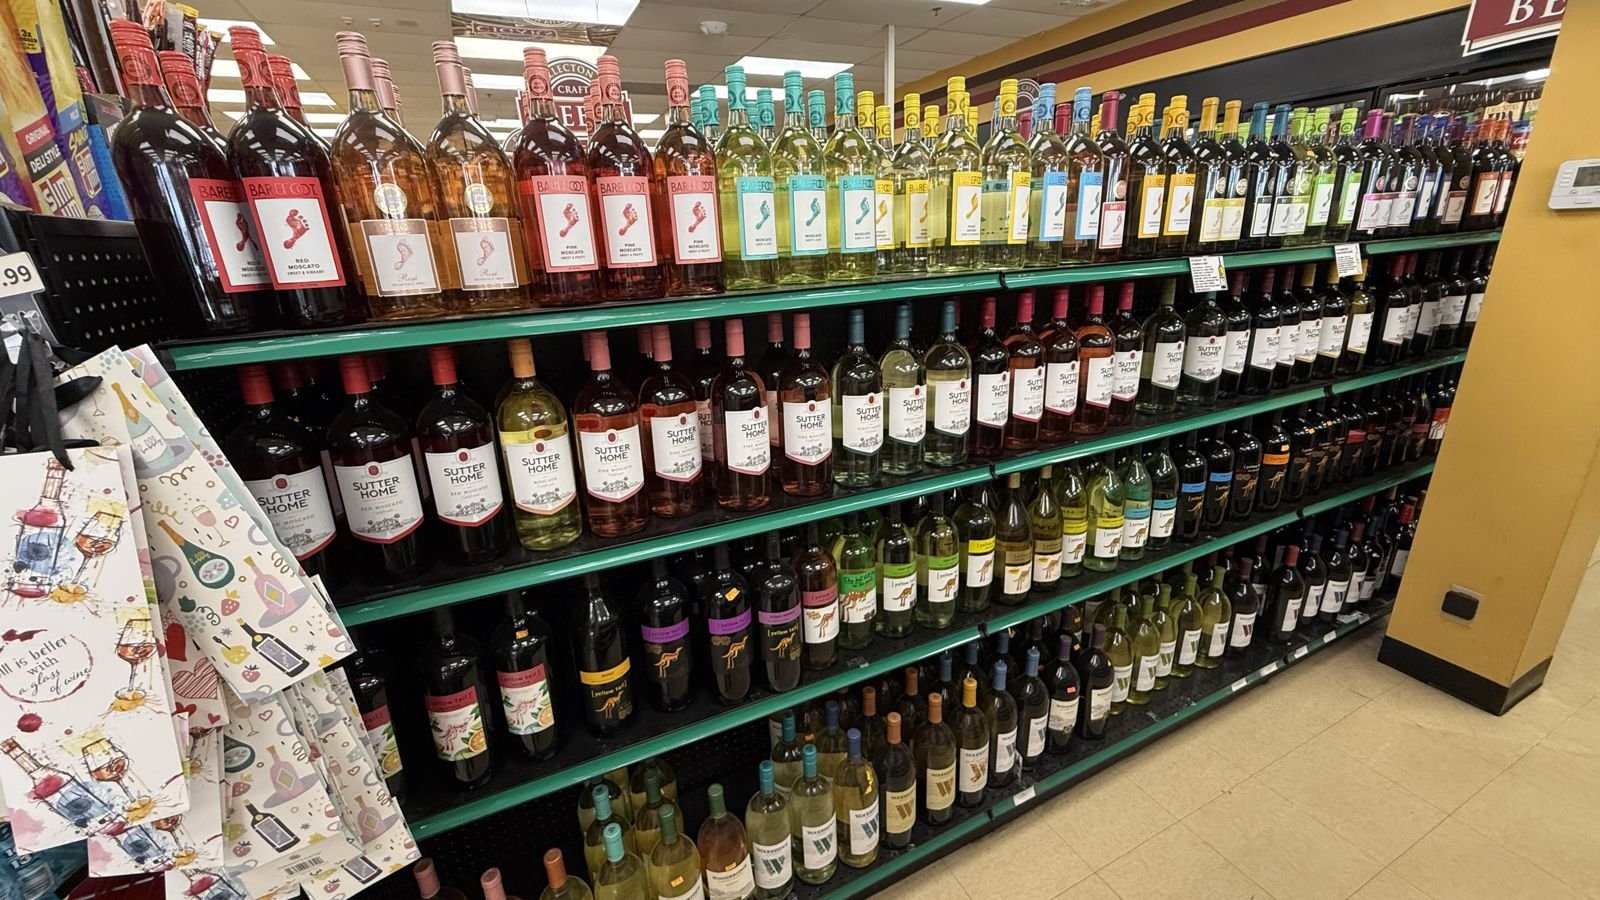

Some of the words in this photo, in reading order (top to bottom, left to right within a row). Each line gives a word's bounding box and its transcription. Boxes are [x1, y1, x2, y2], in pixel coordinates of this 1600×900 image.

[558, 85, 589, 94] CRAFT
[25, 124, 50, 145] ORIGINAL
[30, 155, 46, 173] DELI
[45, 144, 62, 164] STYLE
[250, 182, 319, 197] BAREFOOT
[906, 405, 924, 413] HOME
[796, 414, 826, 423] SUTTER
[860, 413, 879, 421] HOME
[667, 426, 697, 438] SUTTER
[741, 420, 768, 432] SUTTER
[800, 421, 823, 430] HOME
[672, 434, 695, 445] HOME
[746, 428, 766, 438] HOME
[594, 443, 631, 455] SUTTER
[522, 453, 561, 467] SUTTER
[600, 452, 628, 462] HOME
[444, 462, 486, 477] SUTTER
[528, 462, 558, 473] HOME
[352, 476, 401, 491] SUTTER
[451, 471, 484, 484] HOME
[258, 489, 312, 506] SUTTER
[360, 486, 398, 500] HOME
[267, 499, 309, 515] HOME
[374, 500, 404, 510] MOSCATO
[15, 657, 29, 669] is
[29, 636, 68, 661] better
[27, 655, 59, 677] with
[18, 687, 27, 696] a
[30, 669, 61, 696] glass
[50, 678, 62, 696] of
[64, 667, 91, 686] wine
